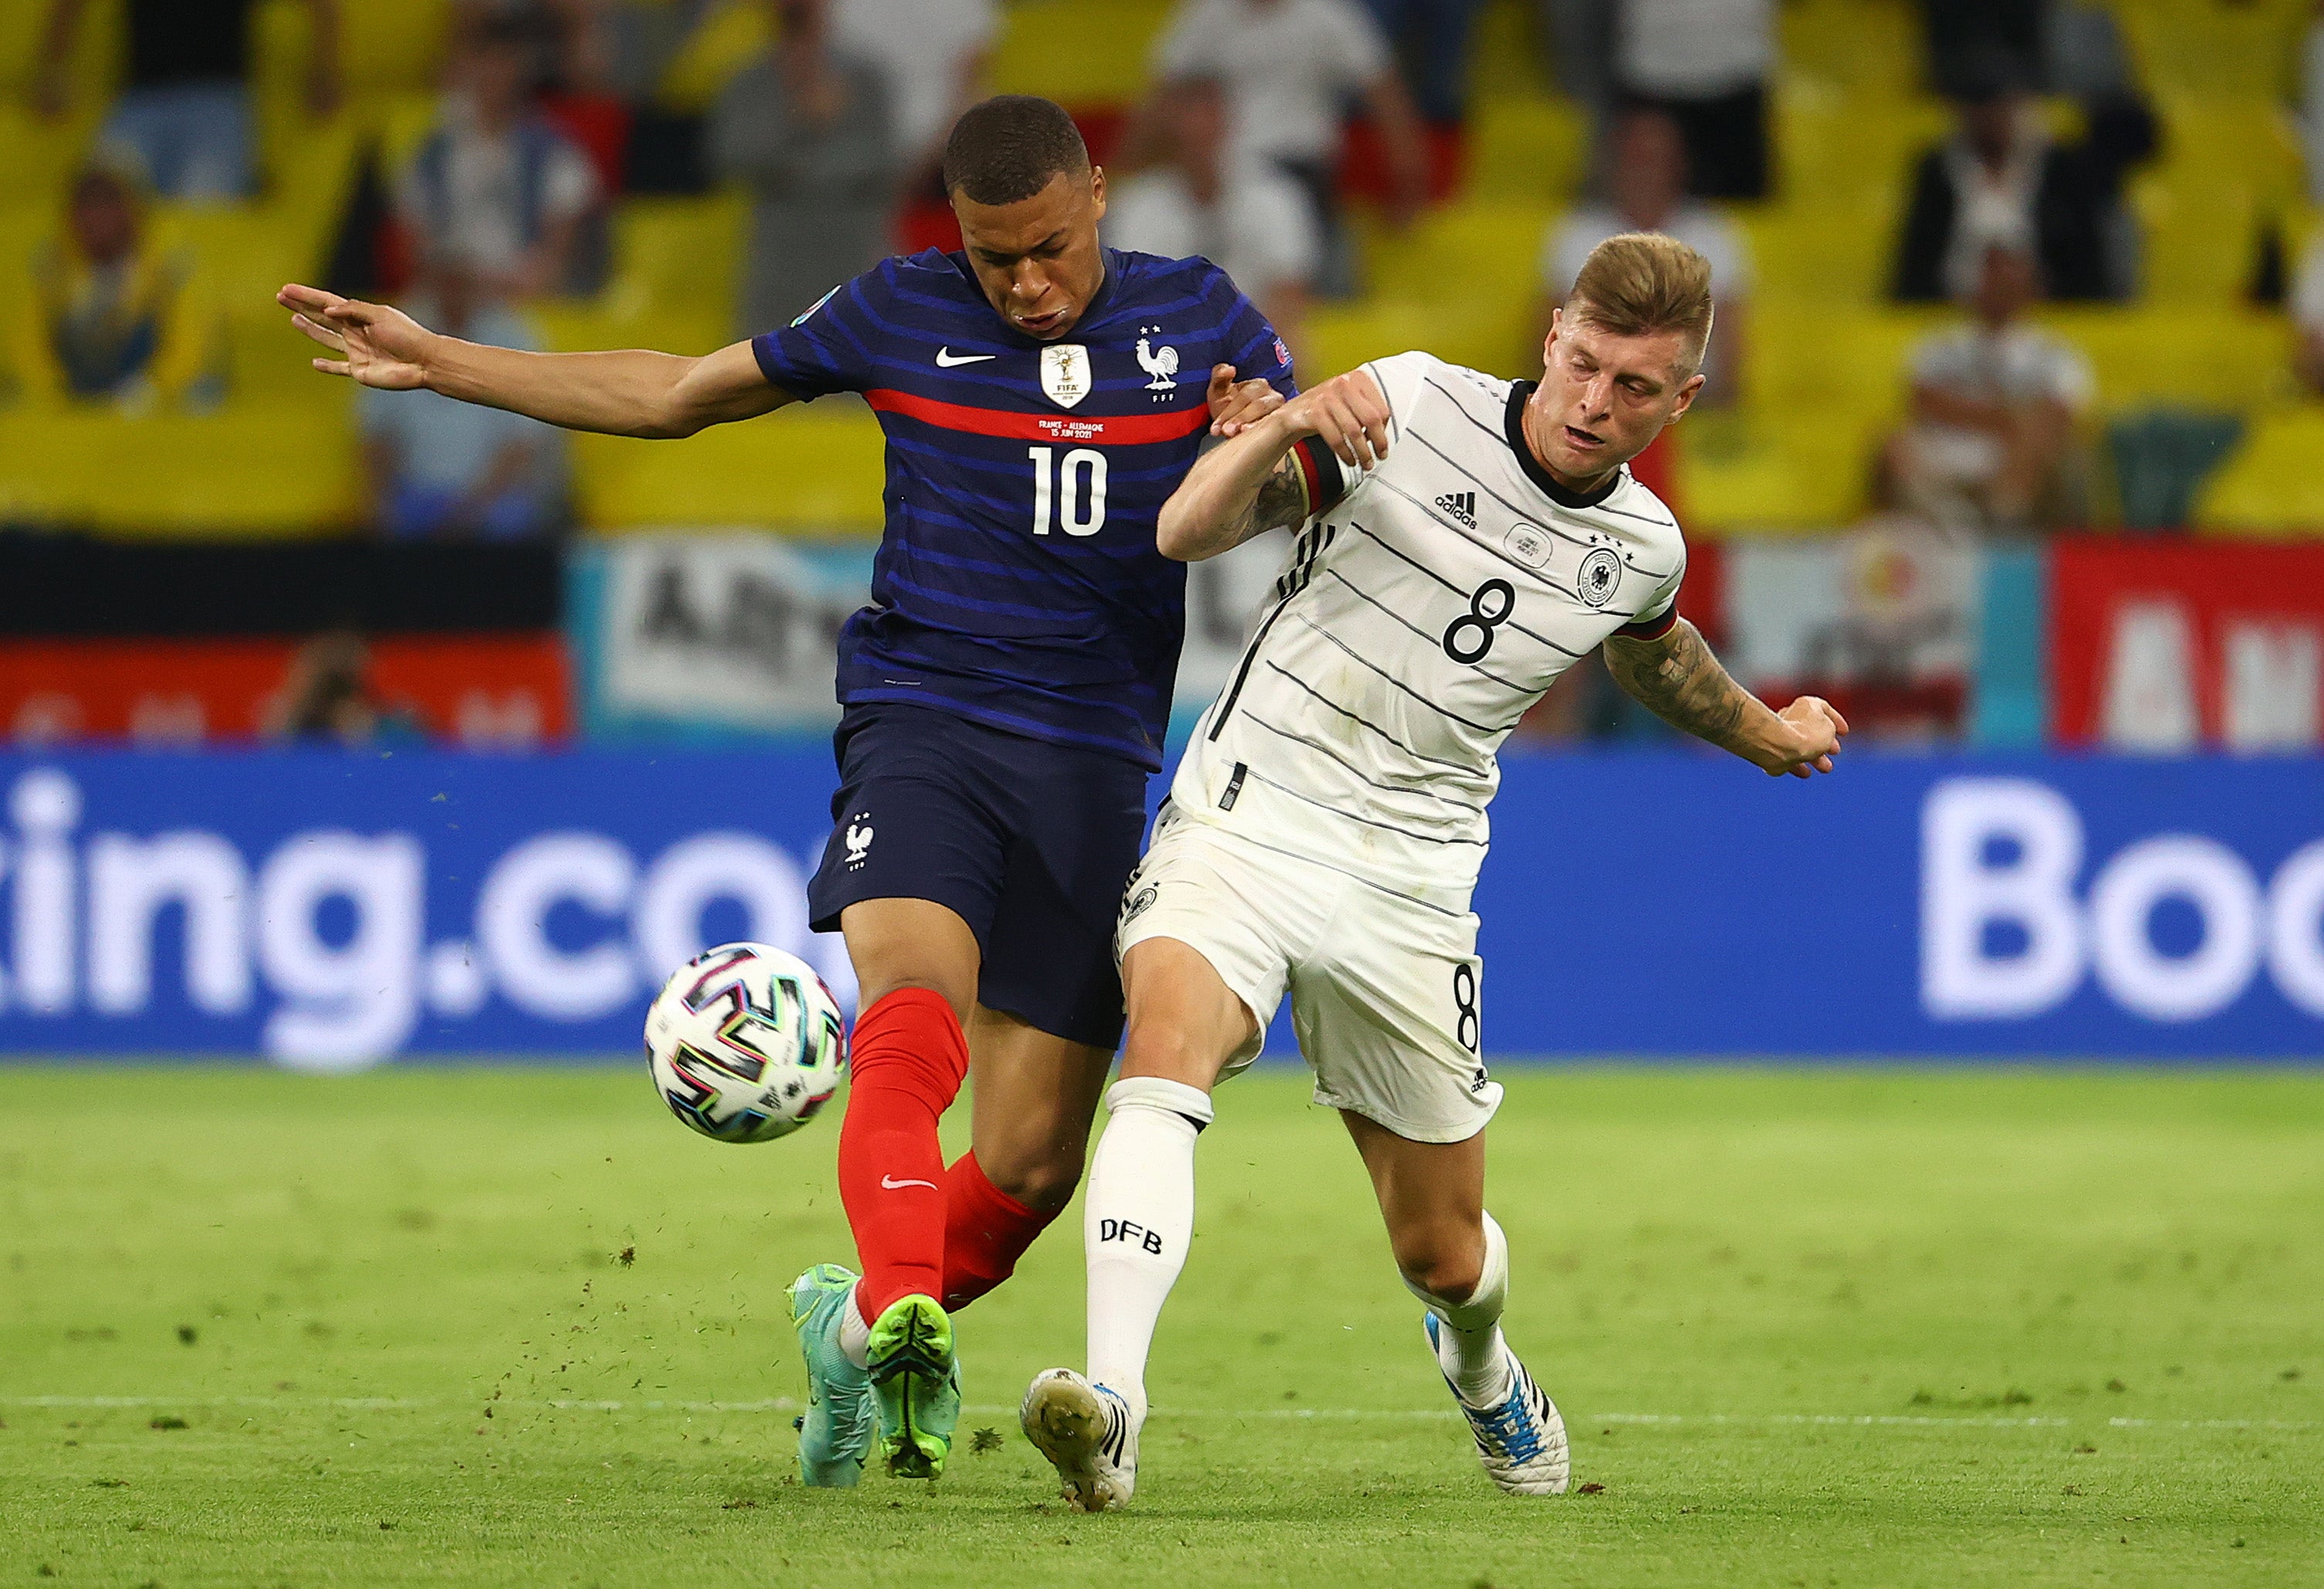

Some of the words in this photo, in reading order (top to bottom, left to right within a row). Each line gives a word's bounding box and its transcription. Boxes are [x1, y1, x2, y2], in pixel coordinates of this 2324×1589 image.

[1039, 420, 1062, 429] FRANCE
[1069, 422, 1104, 432] ALLEMAGNE
[1051, 428, 1059, 437] 15
[1059, 429, 1073, 438] JUN
[1074, 430, 1092, 439] 2021
[1029, 447, 1108, 536] 10
[1434, 496, 1478, 530] adidas
[1443, 577, 1515, 664] 8
[1454, 964, 1478, 1054] 8
[1100, 1219, 1162, 1255] DFB
